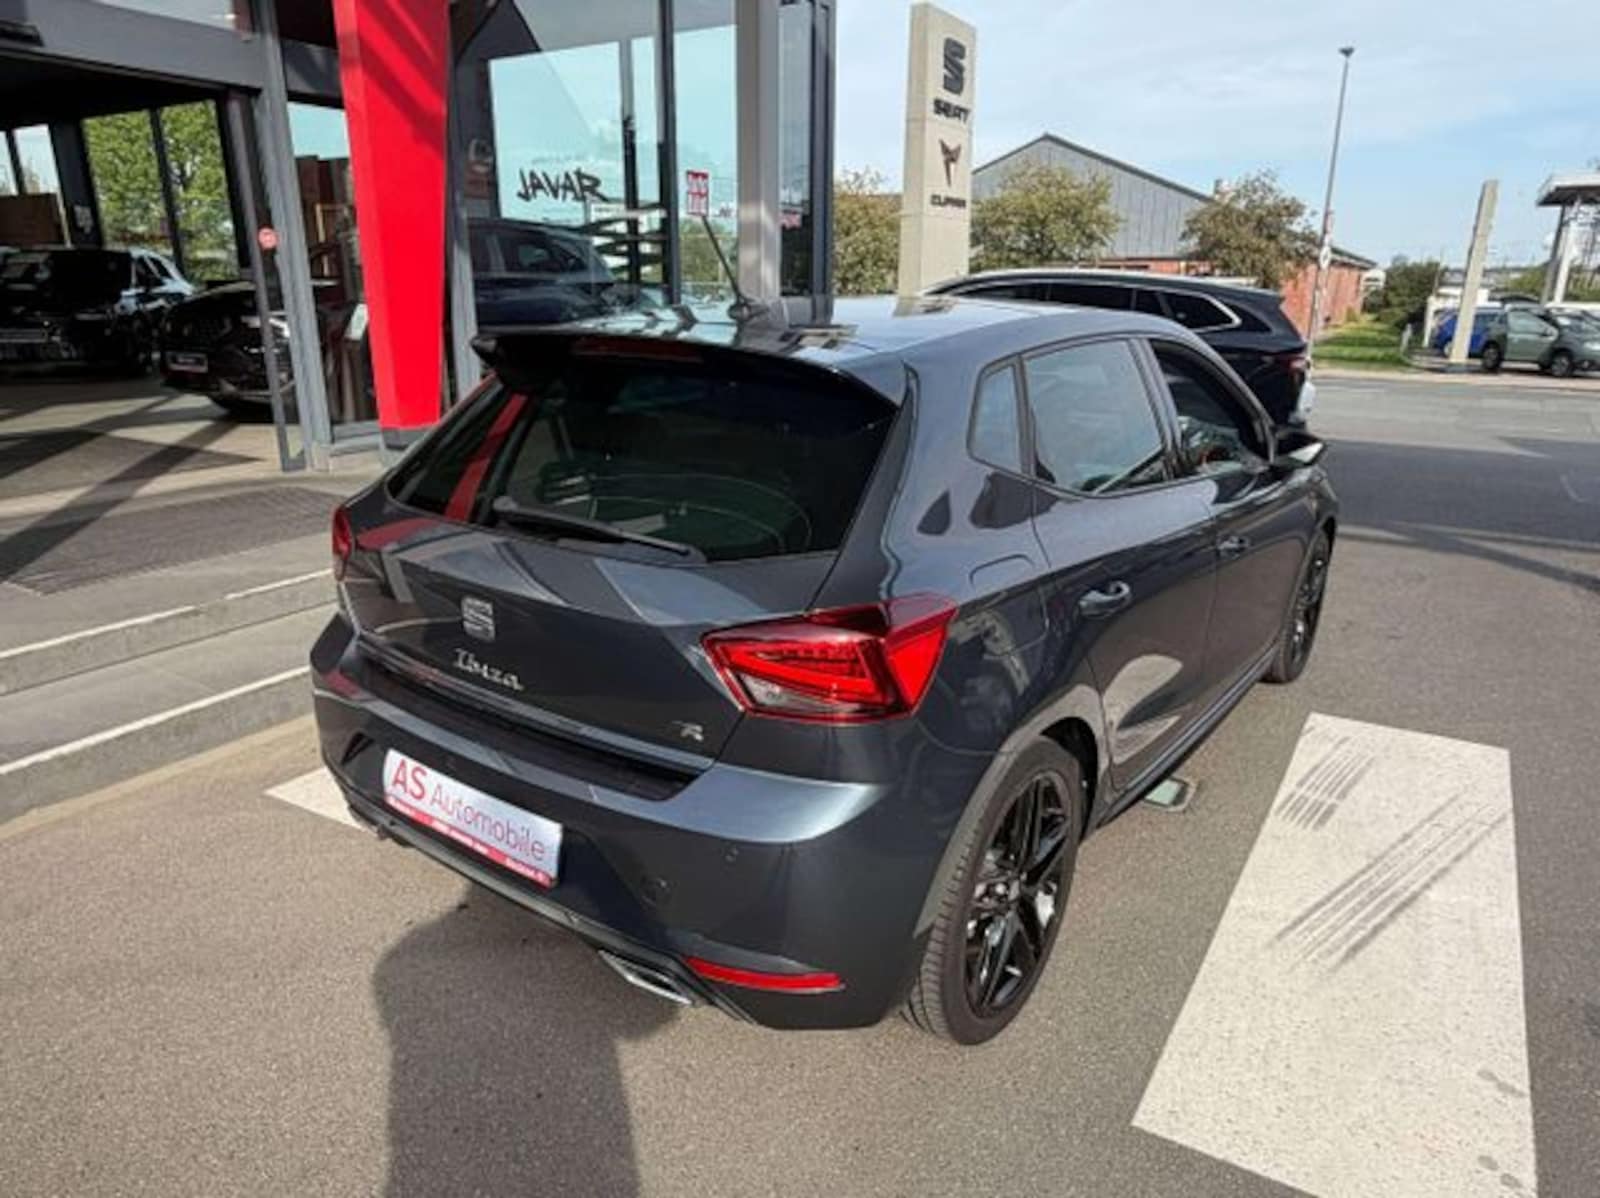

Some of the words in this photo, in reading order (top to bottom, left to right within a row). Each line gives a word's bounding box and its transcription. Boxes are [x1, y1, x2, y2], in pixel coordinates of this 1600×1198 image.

[933, 98, 971, 123] SEAT
[453, 647, 525, 691] Ibiza
[391, 758, 428, 801] AS
[429, 783, 546, 862] Automobile
